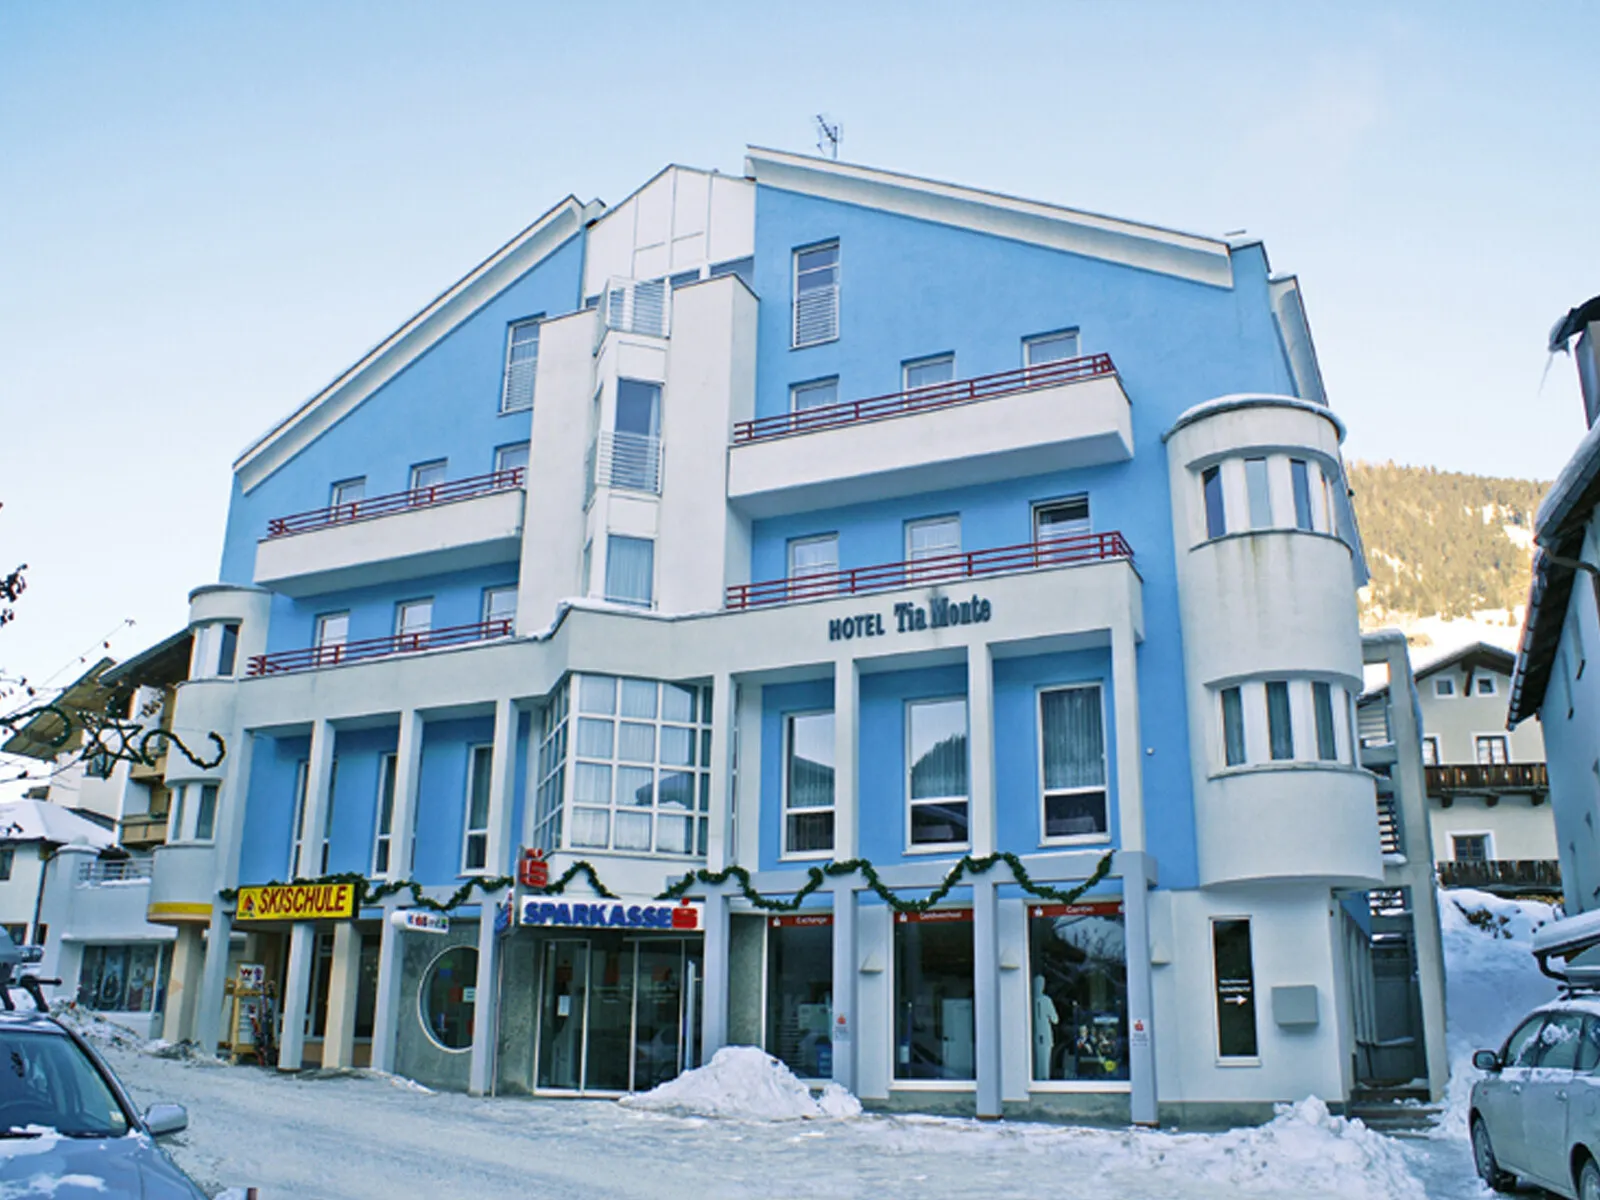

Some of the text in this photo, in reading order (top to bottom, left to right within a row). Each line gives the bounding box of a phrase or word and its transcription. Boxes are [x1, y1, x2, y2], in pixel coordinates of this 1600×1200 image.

[829, 594, 991, 641] HOTEL Tia Monte
[259, 885, 347, 914] SKISCHULE
[524, 902, 672, 928] SPARKASSE
